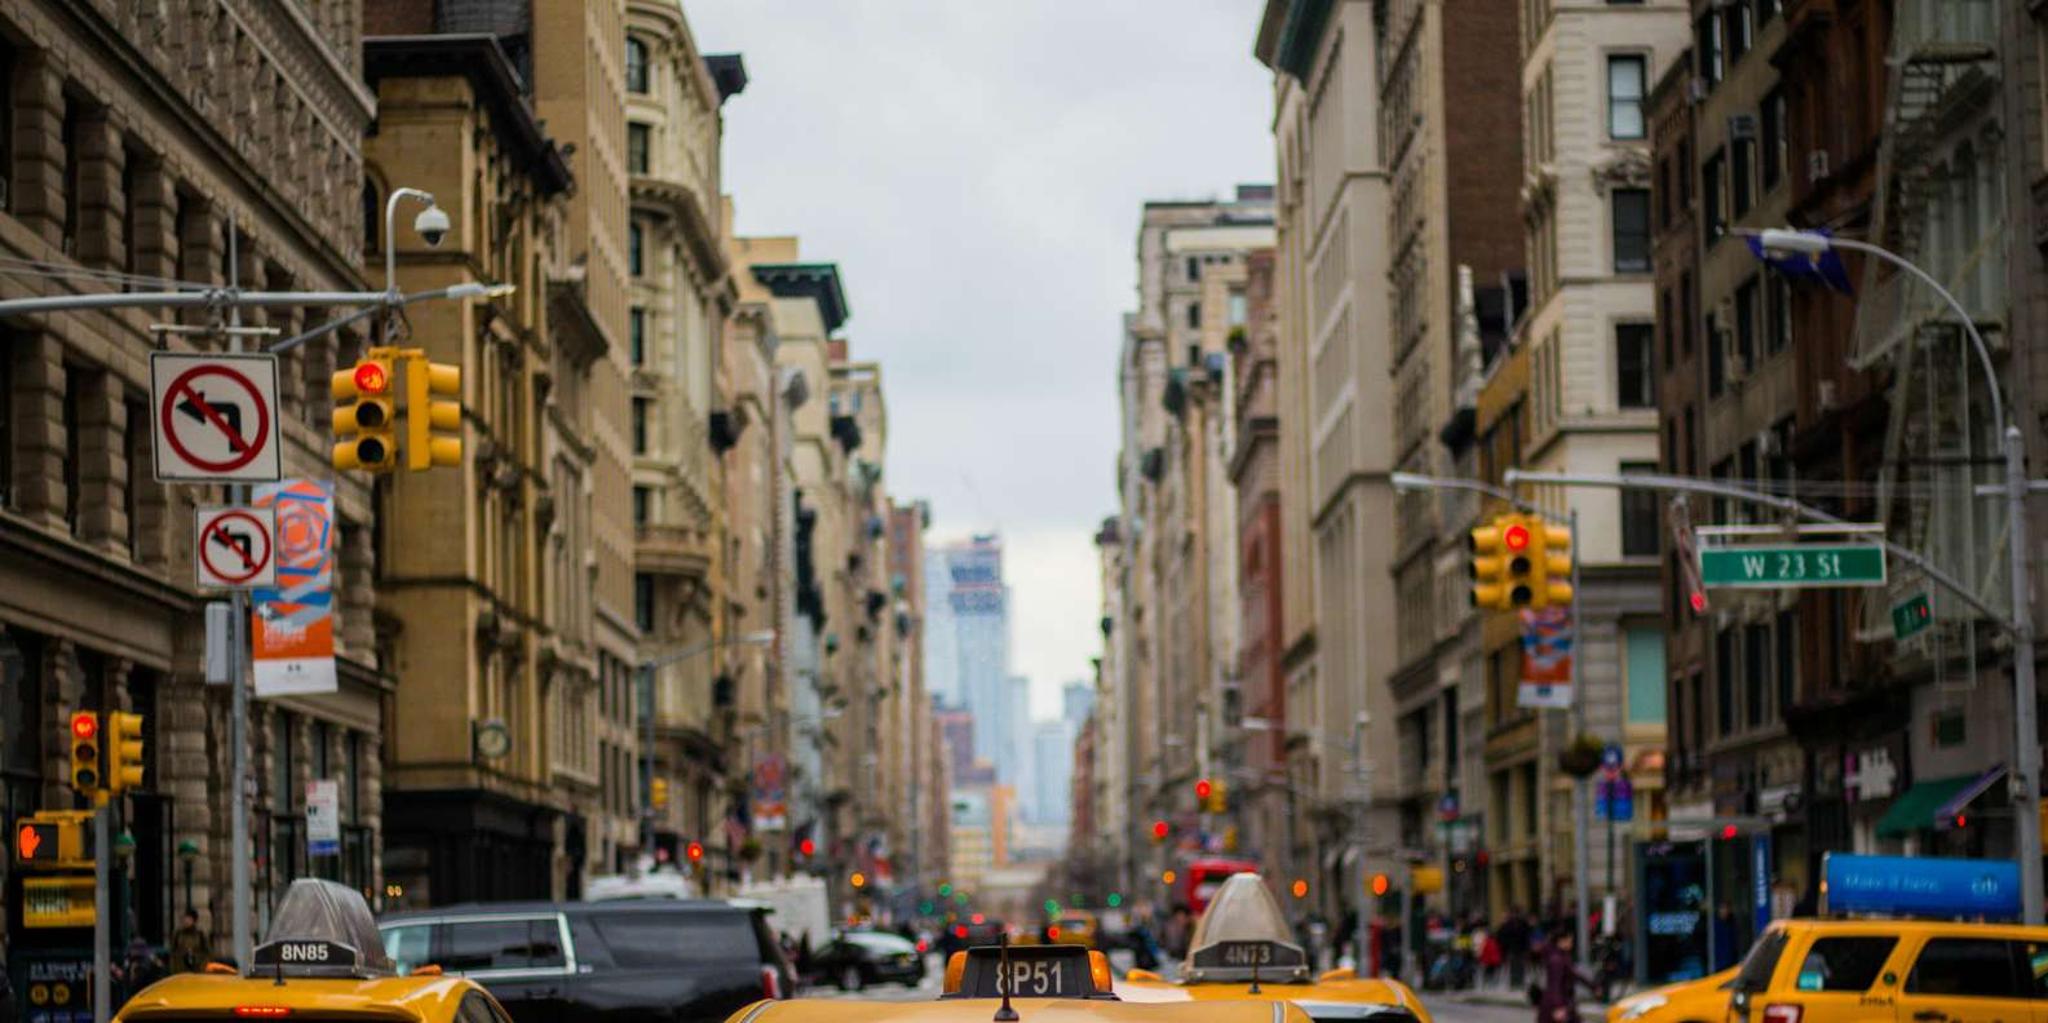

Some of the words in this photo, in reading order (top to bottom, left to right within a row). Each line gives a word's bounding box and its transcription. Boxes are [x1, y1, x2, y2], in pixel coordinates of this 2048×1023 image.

[1742, 554, 1765, 578] W
[1778, 554, 1805, 578] 23
[1817, 553, 1841, 577] St
[281, 943, 328, 961] 8N85
[1225, 944, 1271, 964] 4N73
[995, 960, 1062, 995] 8P51
